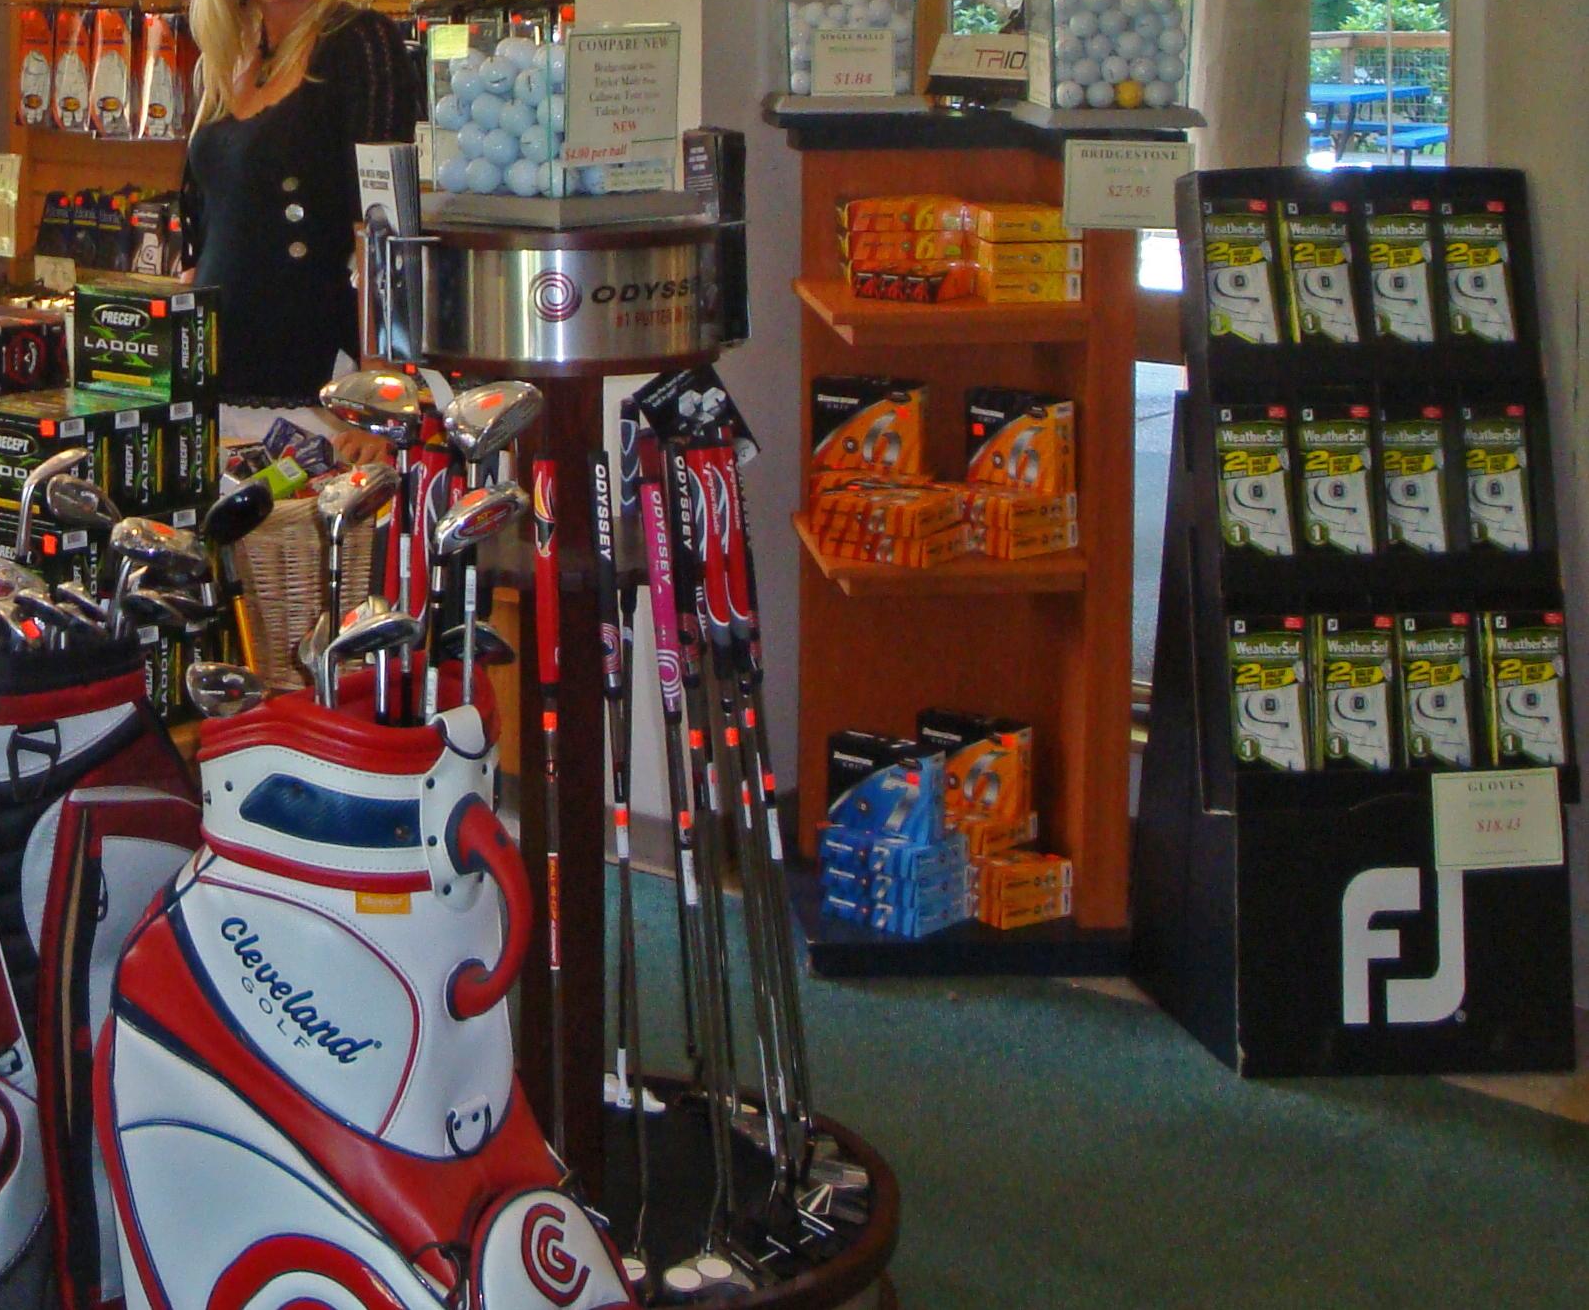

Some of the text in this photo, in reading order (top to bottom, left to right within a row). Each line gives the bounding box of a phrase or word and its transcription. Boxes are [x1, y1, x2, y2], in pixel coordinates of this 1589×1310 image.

[578, 37, 668, 52] COMPARE NEW
[975, 48, 1027, 70] TRIO
[833, 72, 873, 86] $1.84
[613, 121, 637, 133] NEW
[1081, 149, 1178, 161] BRIDGESTONE
[1206, 242, 1229, 263] 2
[1294, 242, 1315, 262] 2
[1369, 243, 1389, 262] 2
[1446, 242, 1469, 262] 2
[100, 310, 141, 328] PRECEPT
[83, 336, 159, 356] LADDIE
[181, 326, 190, 369] PRECEPT
[196, 305, 205, 386] LADDIE
[141, 422, 149, 504] LADDIE
[179, 435, 188, 477] PRECEPT
[195, 413, 203, 493] LADDIE
[1223, 450, 1248, 472] 2
[1306, 450, 1329, 471] 2
[1383, 450, 1402, 470] 2
[1466, 448, 1486, 469] 2
[125, 444, 134, 487] PRECEPT
[595, 462, 612, 560] ODYSSEY
[674, 455, 693, 550] ODYSSEY
[650, 490, 671, 585] ODYSSEY
[1235, 662, 1261, 684] 2
[1327, 661, 1353, 682] 2
[1407, 660, 1431, 682] 2
[1498, 658, 1522, 680] 2
[1467, 780, 1525, 793] GLOVES
[1342, 867, 1466, 1025] FJ
[221, 917, 373, 1064] Cleveland
[241, 976, 310, 1048] GOLF
